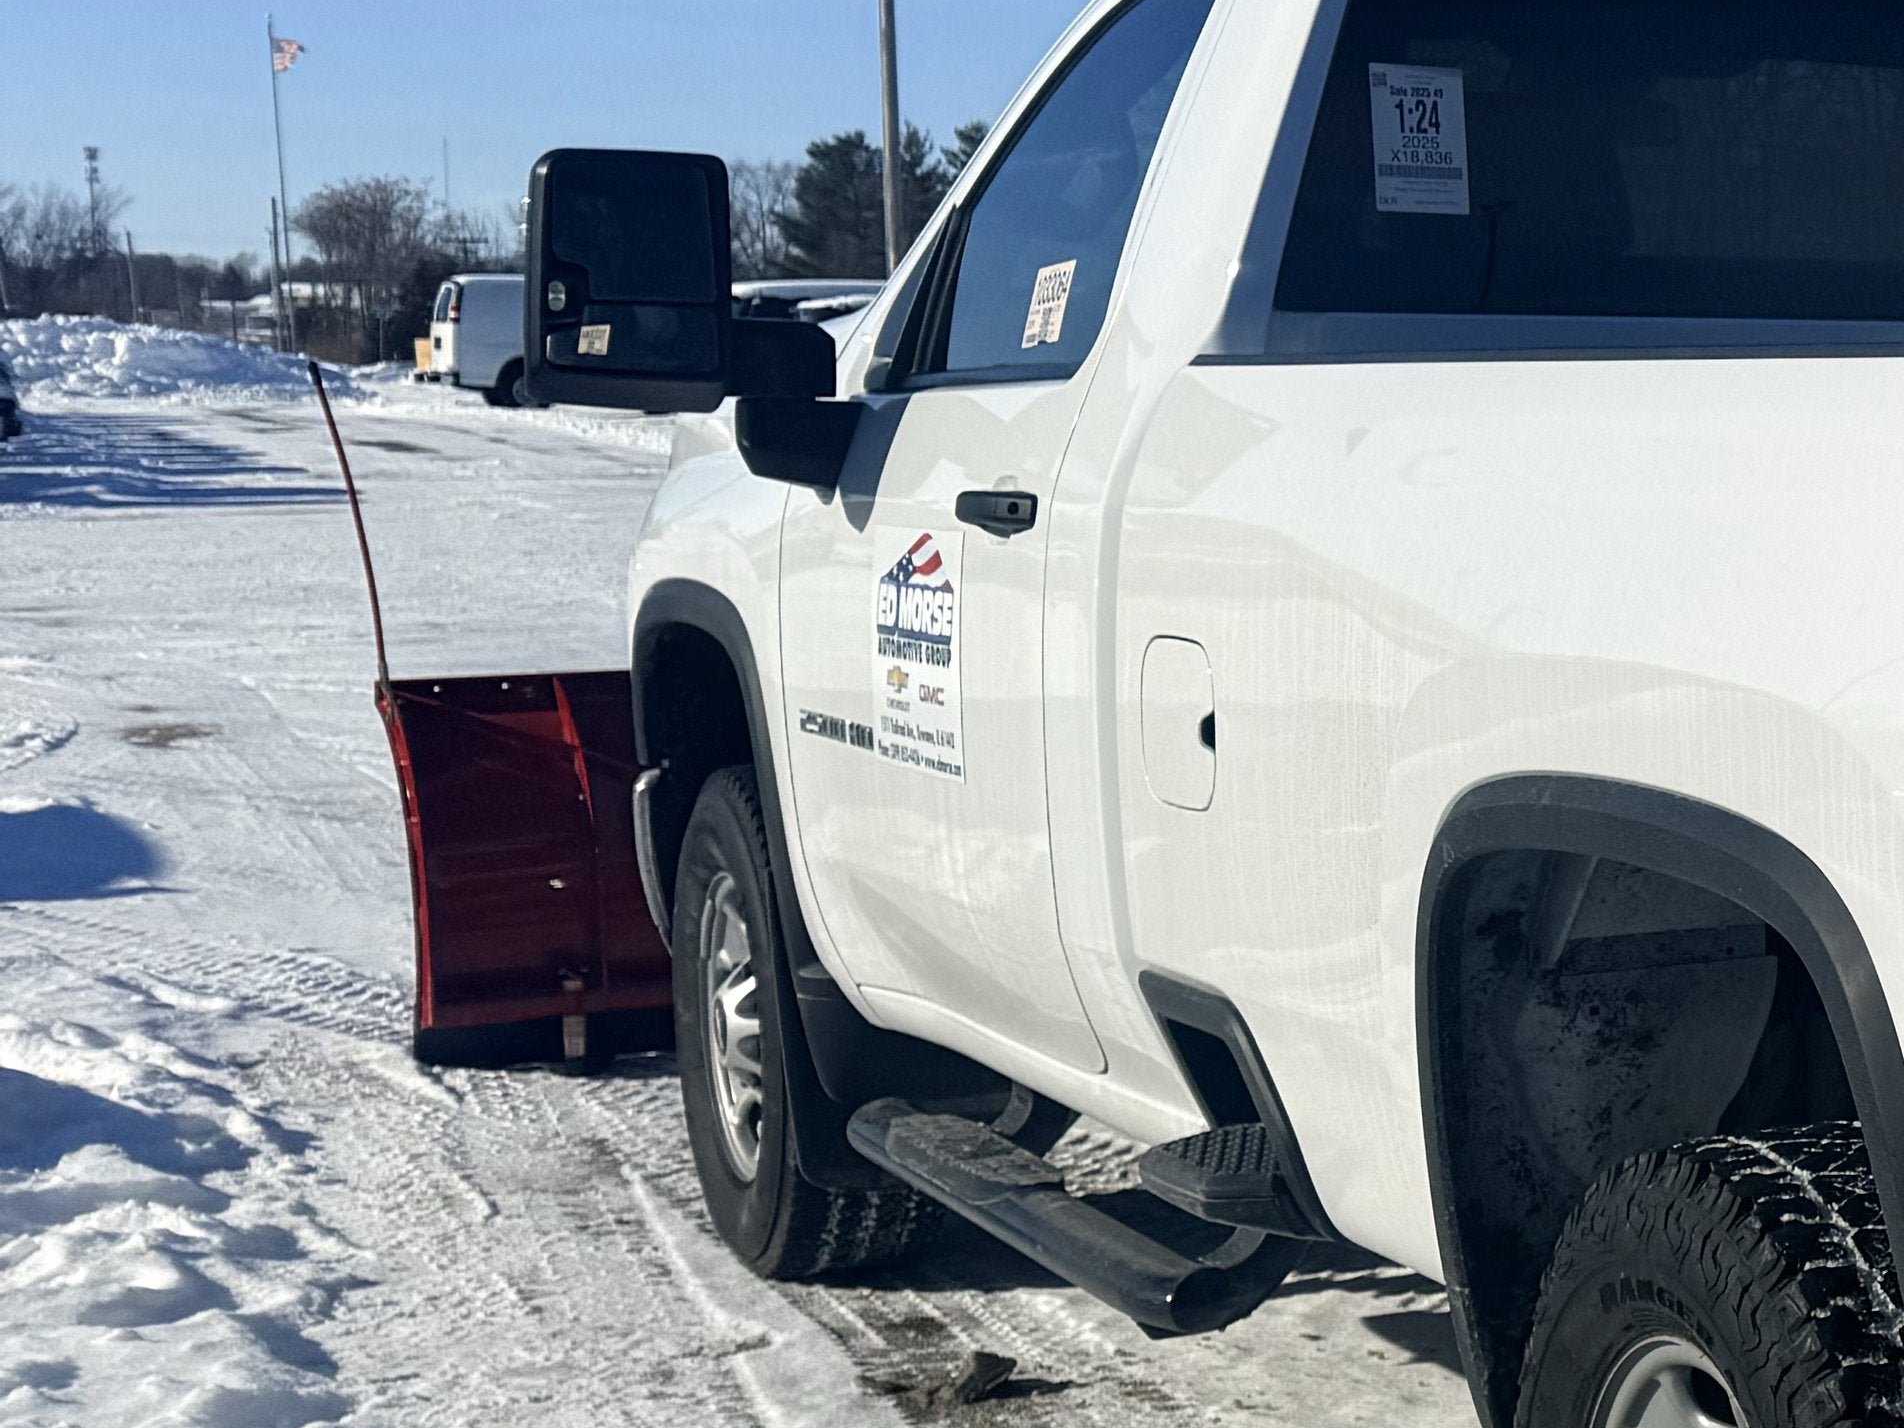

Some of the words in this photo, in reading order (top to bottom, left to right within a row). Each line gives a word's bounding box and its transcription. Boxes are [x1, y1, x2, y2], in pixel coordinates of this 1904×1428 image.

[1394, 98, 1441, 135] 1:24
[1402, 135, 1440, 150] 2025
[877, 582, 898, 628] ED
[898, 585, 953, 638] MORSE
[878, 636, 922, 664] AUTOMOTIVE
[925, 643, 952, 669] GROUP
[919, 684, 945, 707] GMC
